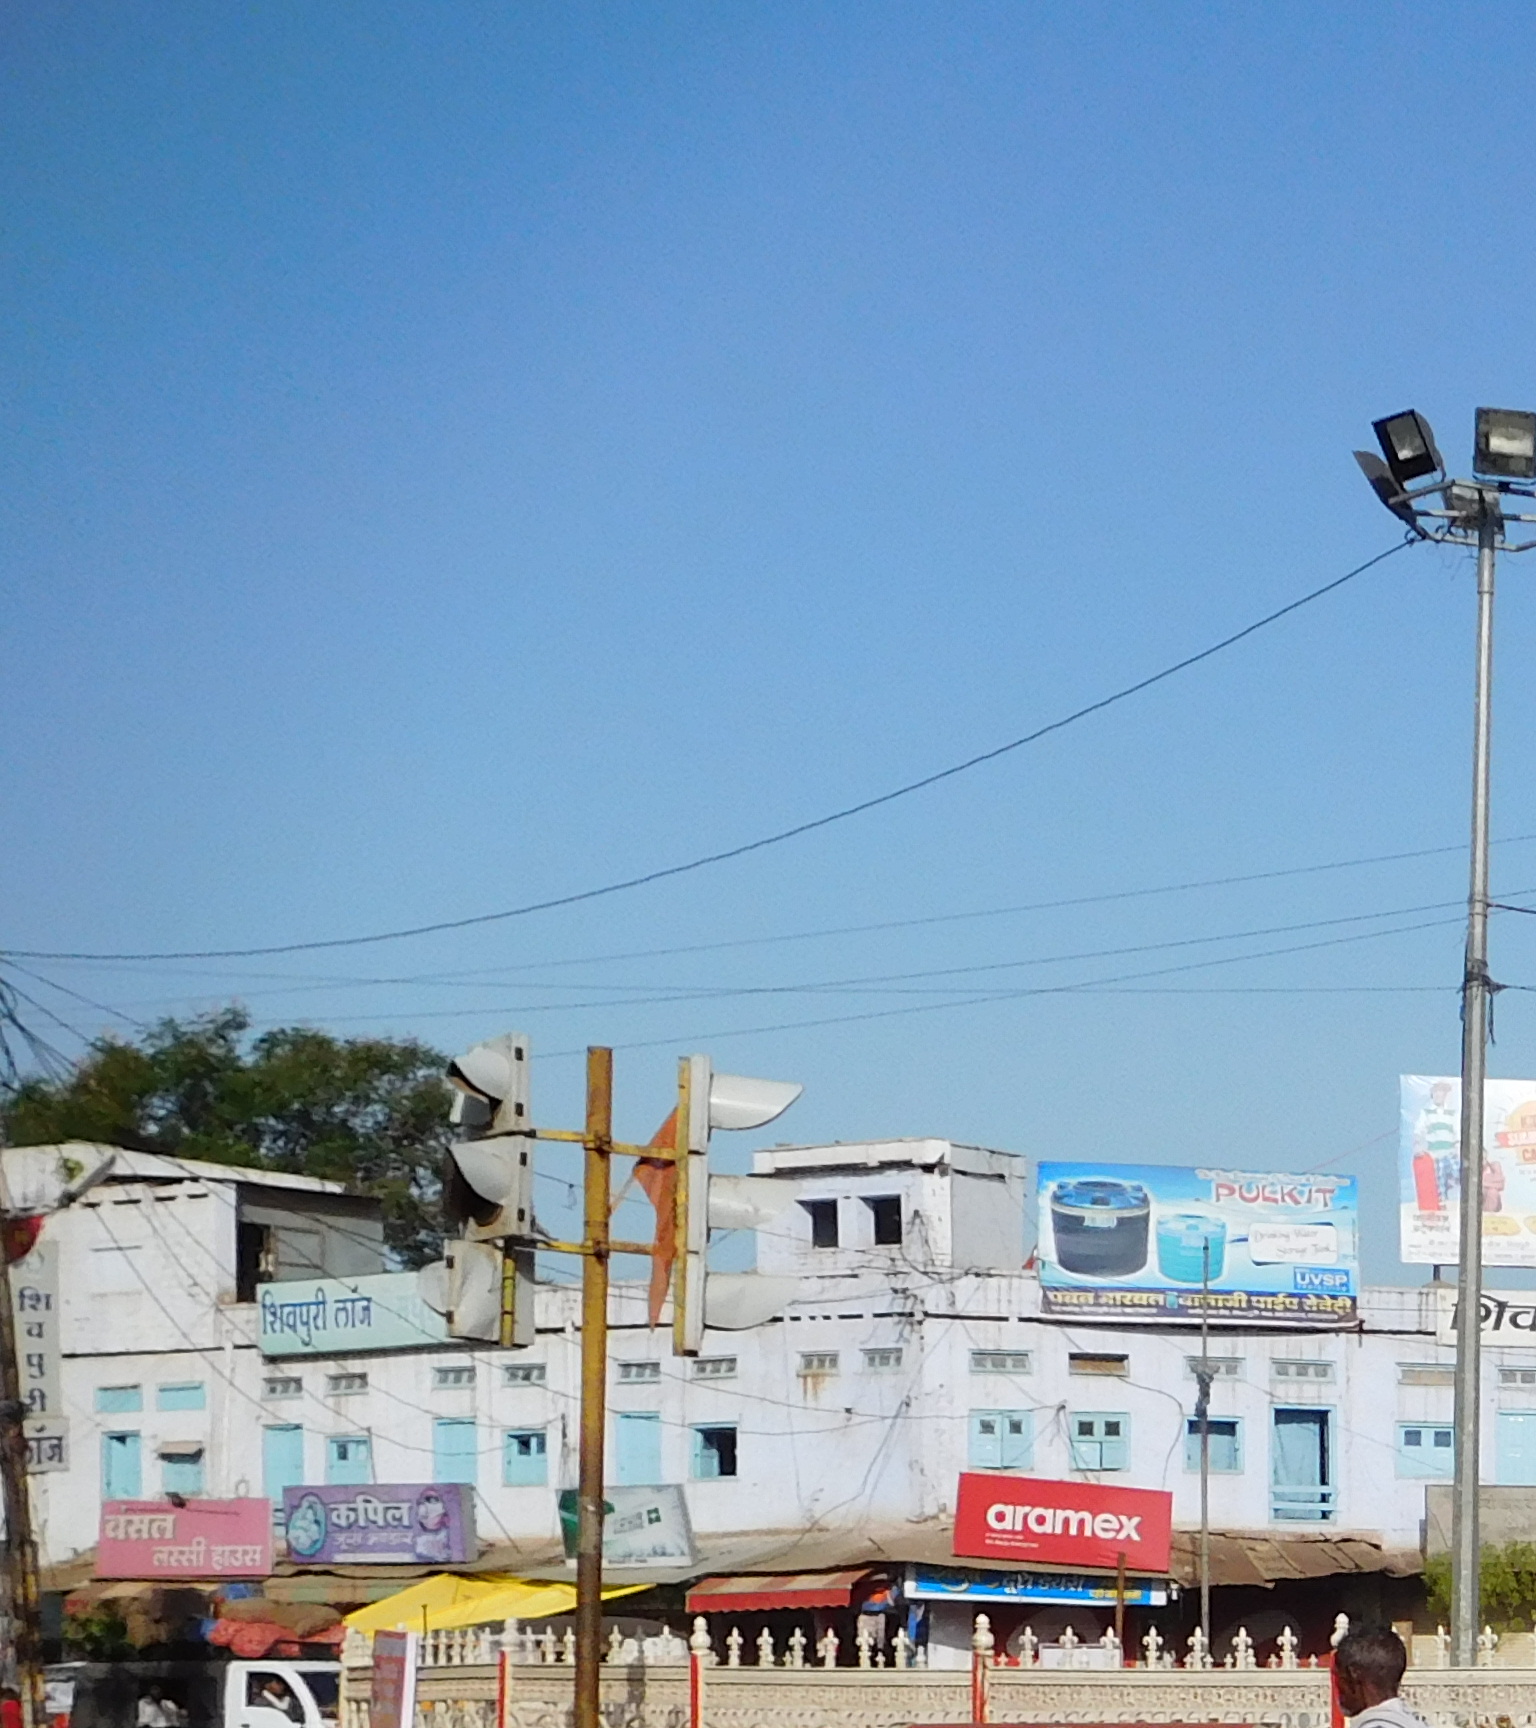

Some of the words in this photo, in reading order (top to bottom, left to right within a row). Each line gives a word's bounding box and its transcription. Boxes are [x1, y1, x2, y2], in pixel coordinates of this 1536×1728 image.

[1215, 1182, 1336, 1208] PULKIT
[1295, 1271, 1349, 1287] UVSP
[262, 1288, 327, 1347] शिवपुरी
[330, 1493, 413, 1530] कपिल
[986, 1503, 1142, 1542] aramex
[153, 1536, 205, 1568] लस्सी
[210, 1544, 263, 1571] हाउस
